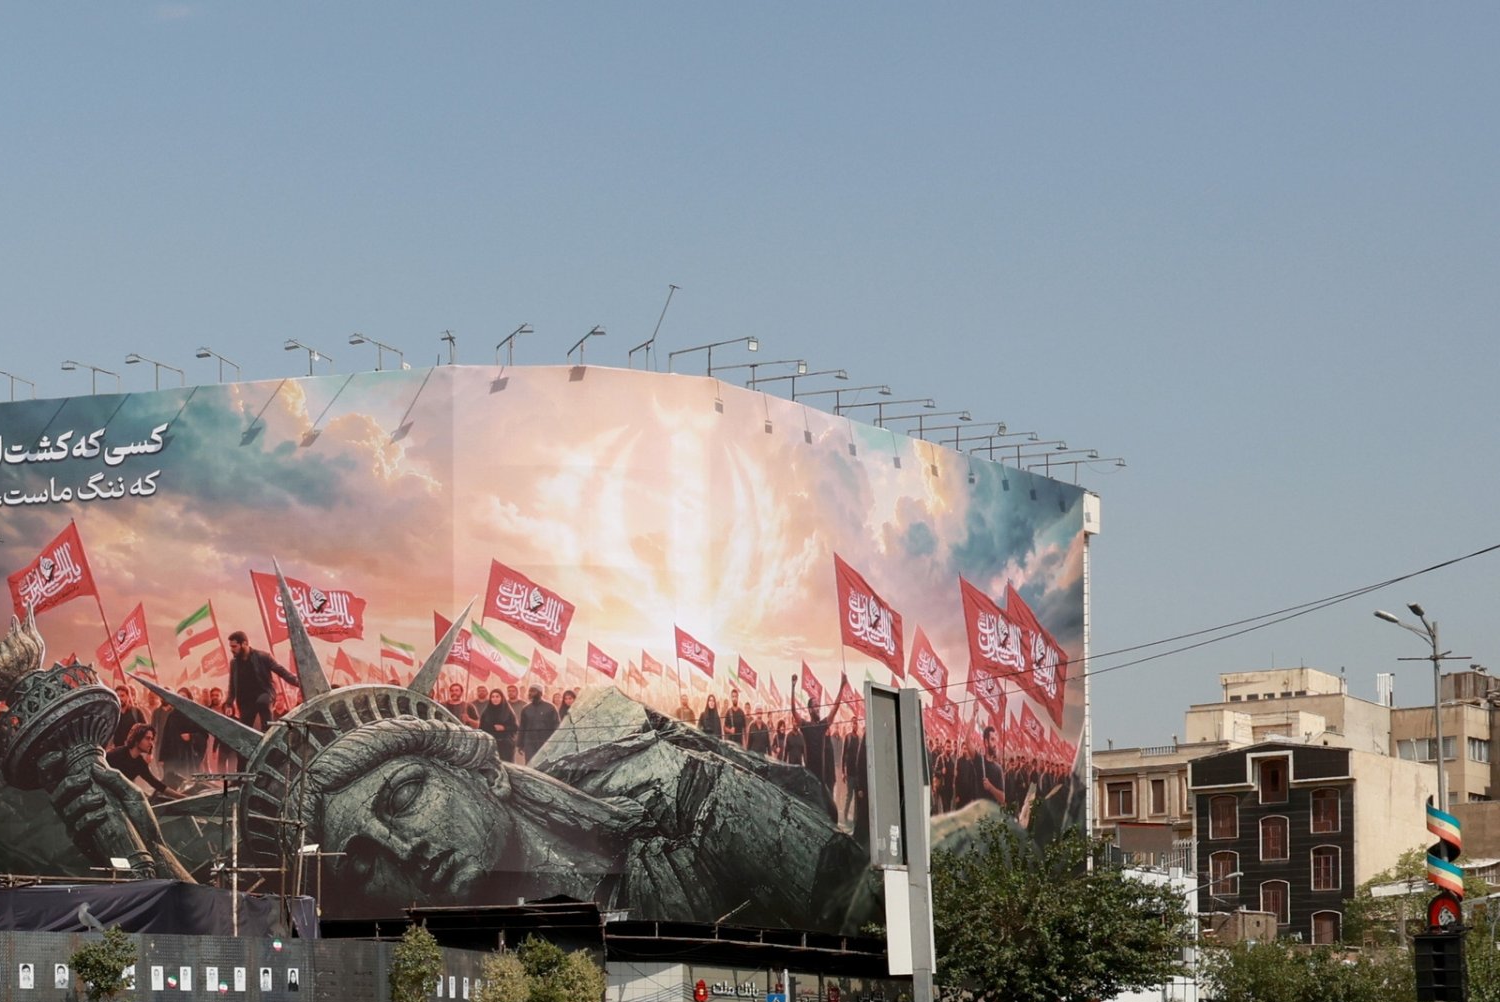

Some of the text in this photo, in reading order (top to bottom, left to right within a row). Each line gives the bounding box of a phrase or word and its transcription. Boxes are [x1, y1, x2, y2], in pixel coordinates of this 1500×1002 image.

[4, 430, 74, 463] کشت
[72, 428, 105, 458] که
[104, 423, 168, 465] کسی
[77, 472, 124, 500] ننگ
[130, 470, 160, 496] که
[712, 981, 759, 1002] بانک ملت
